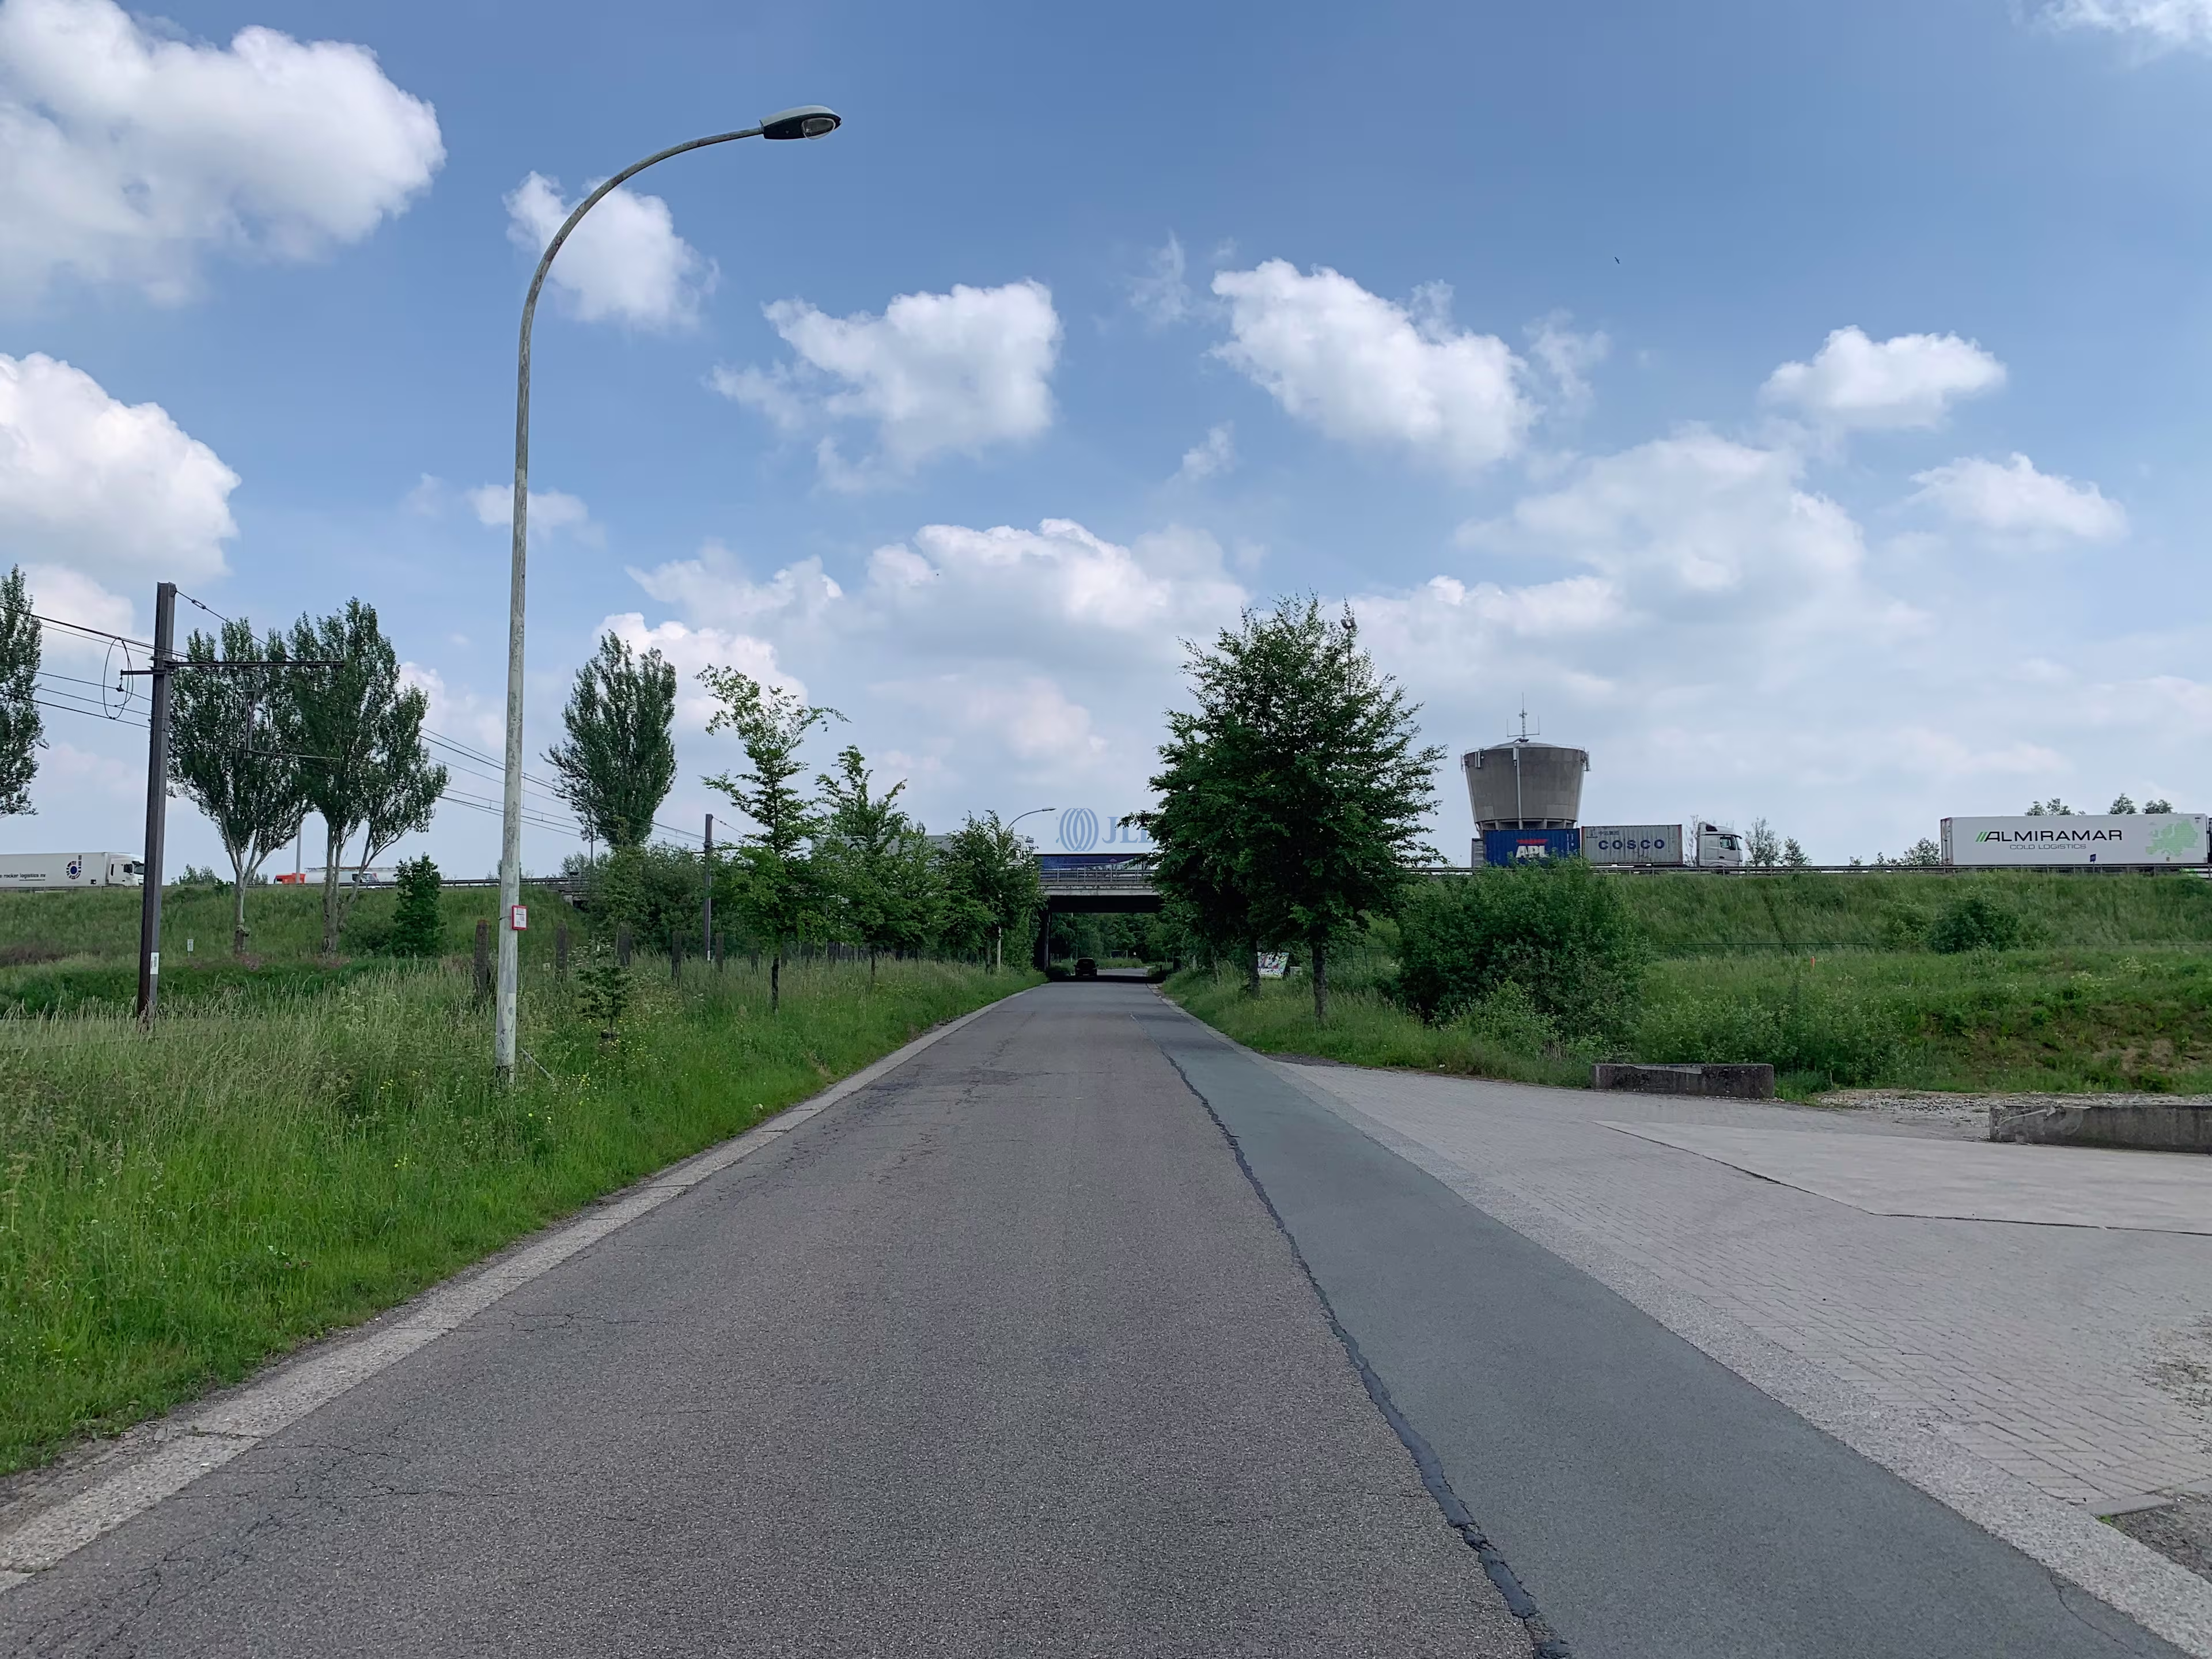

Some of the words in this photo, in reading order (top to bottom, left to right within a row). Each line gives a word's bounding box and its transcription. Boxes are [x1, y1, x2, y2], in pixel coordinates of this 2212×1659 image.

[1984, 830, 2123, 842] ALMIRAMAR
[1598, 839, 1665, 850] COSCO
[1516, 845, 1549, 858] APL
